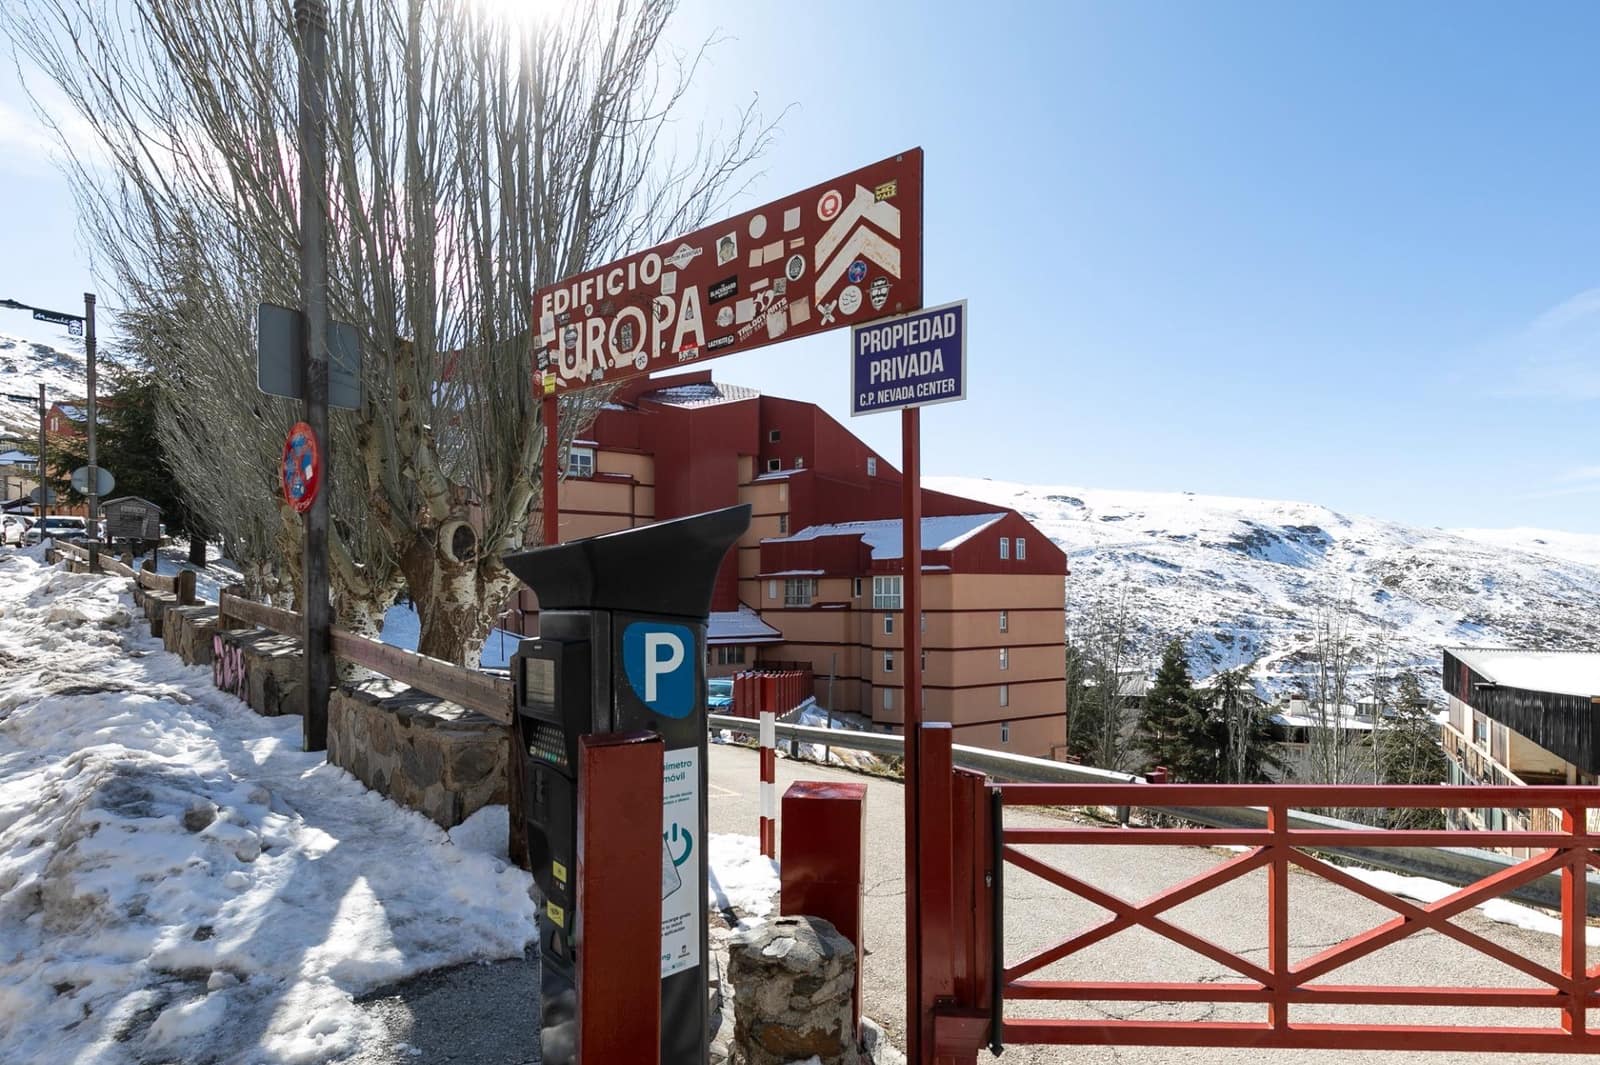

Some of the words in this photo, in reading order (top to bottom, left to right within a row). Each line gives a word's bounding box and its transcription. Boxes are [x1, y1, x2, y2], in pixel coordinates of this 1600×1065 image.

[541, 253, 662, 319] EDIFICIO
[539, 285, 706, 386] UROPA
[860, 312, 956, 355] PROPIEDAD
[859, 392, 876, 407] C.P.
[877, 385, 915, 404] NEVADA
[916, 378, 955, 397] CENTER
[870, 348, 944, 385] PRIVADA
[645, 632, 685, 702] P
